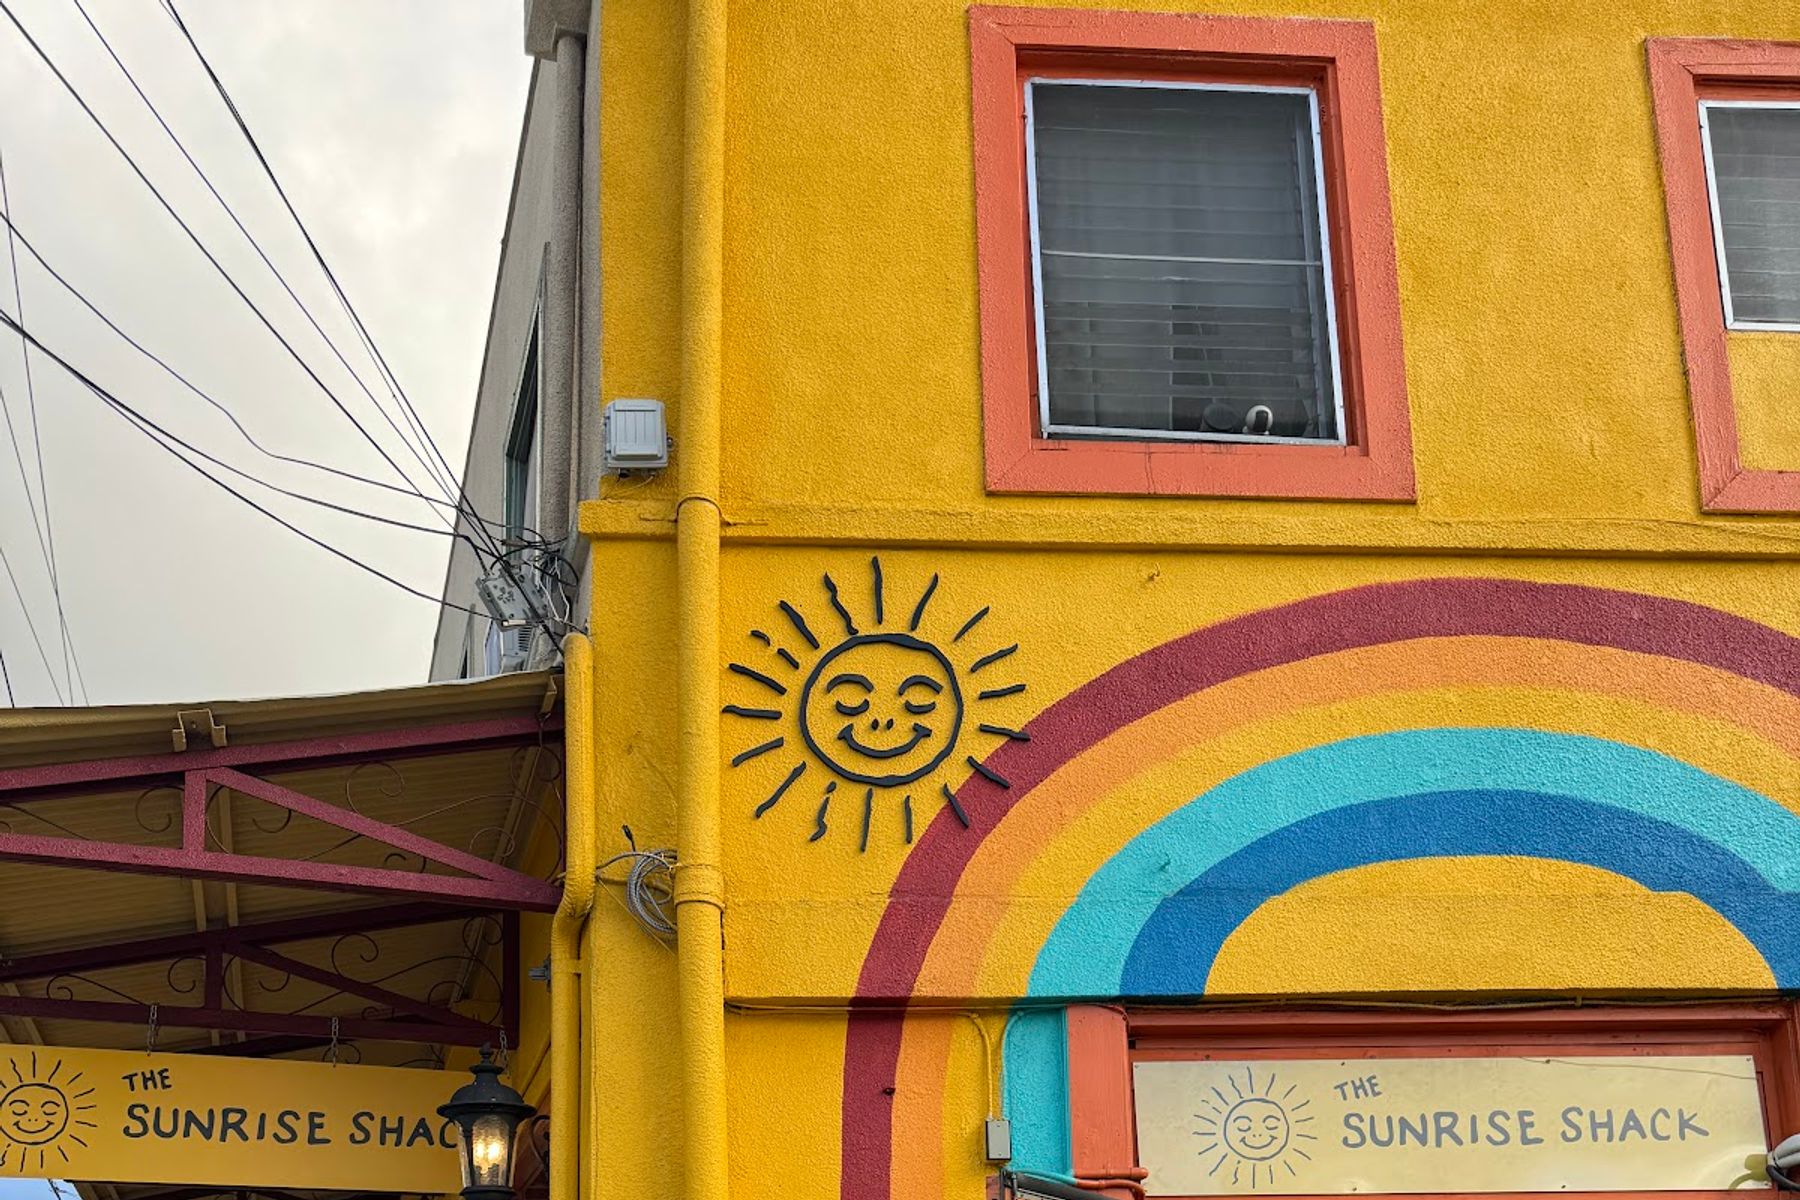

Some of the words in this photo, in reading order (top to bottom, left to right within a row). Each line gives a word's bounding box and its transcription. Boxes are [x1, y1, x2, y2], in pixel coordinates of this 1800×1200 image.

[122, 1068, 172, 1091] THE
[1333, 1074, 1383, 1101] THE
[122, 1103, 332, 1145] SUNRISE
[349, 1111, 459, 1149] SHAC
[1342, 1110, 1545, 1149] SUNRISE
[1560, 1106, 1710, 1143] SHACK
